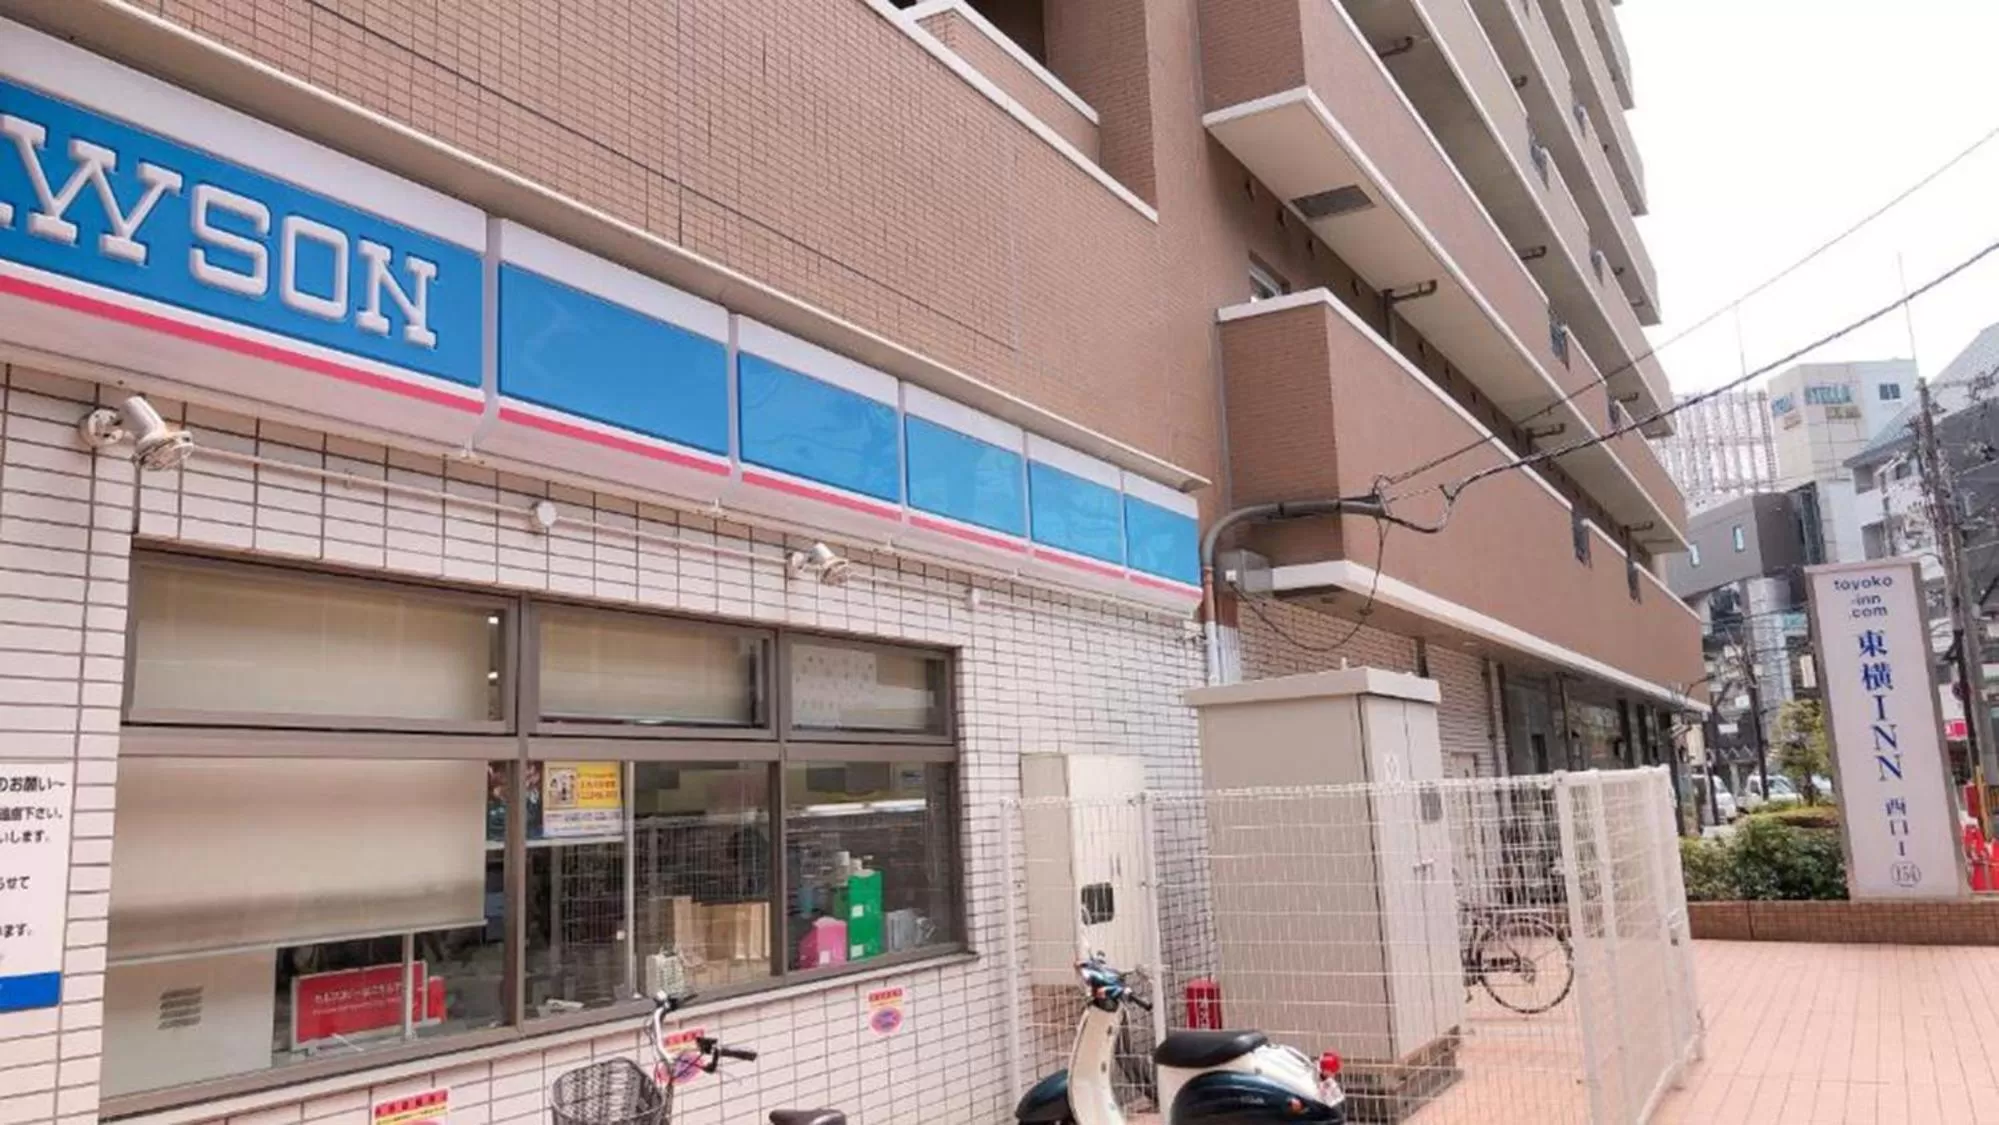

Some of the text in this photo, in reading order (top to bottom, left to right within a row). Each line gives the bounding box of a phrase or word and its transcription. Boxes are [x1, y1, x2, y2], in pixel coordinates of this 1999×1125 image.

[0, 113, 437, 349] WSON
[1833, 575, 1893, 590] toyoko
[1858, 629, 1903, 782] 東横INN
